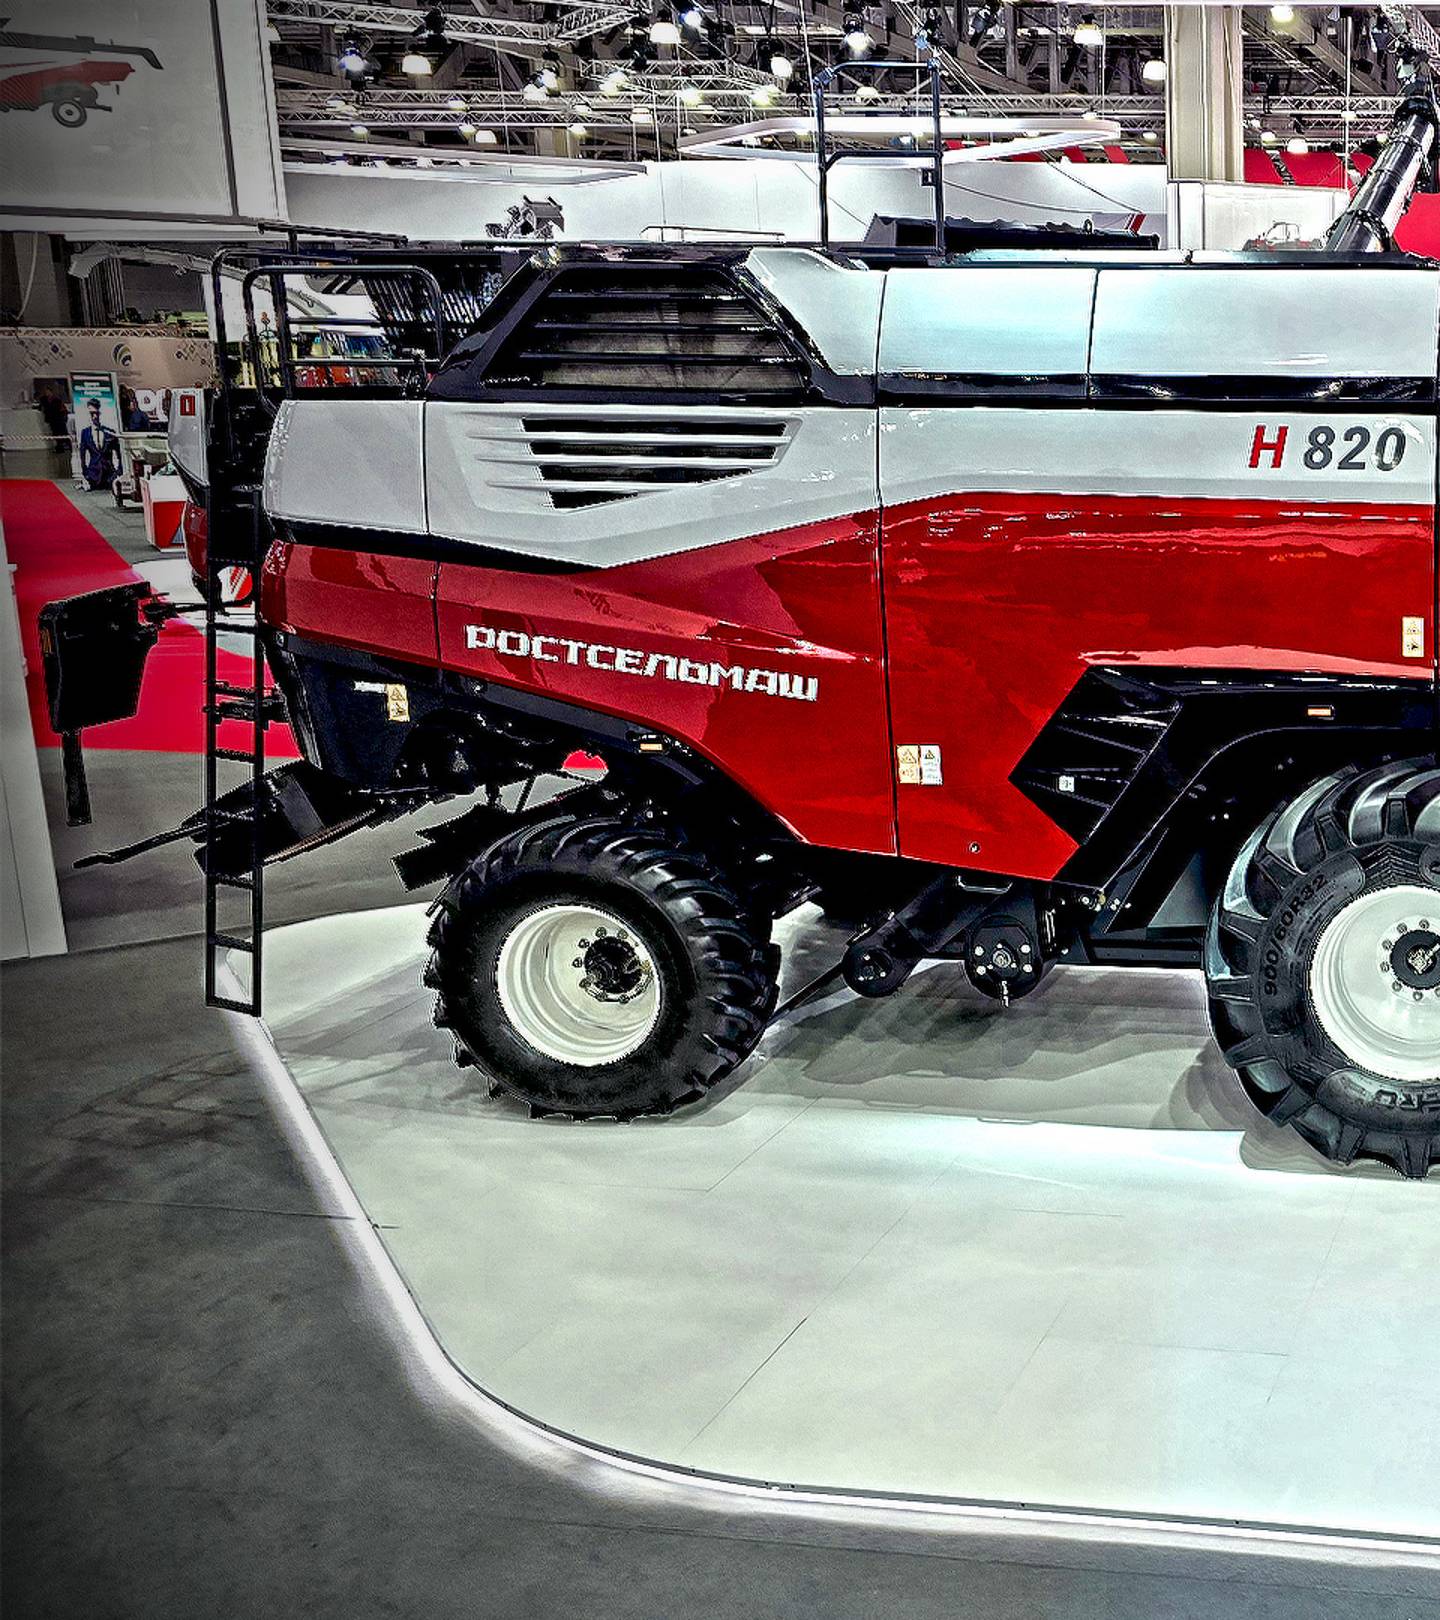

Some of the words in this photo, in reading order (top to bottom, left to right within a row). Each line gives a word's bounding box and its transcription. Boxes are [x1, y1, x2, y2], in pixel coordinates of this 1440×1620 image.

[1248, 424, 1289, 469] H
[1303, 425, 1407, 471] 820
[464, 624, 819, 702] РОСТСЕЛЬМАШ
